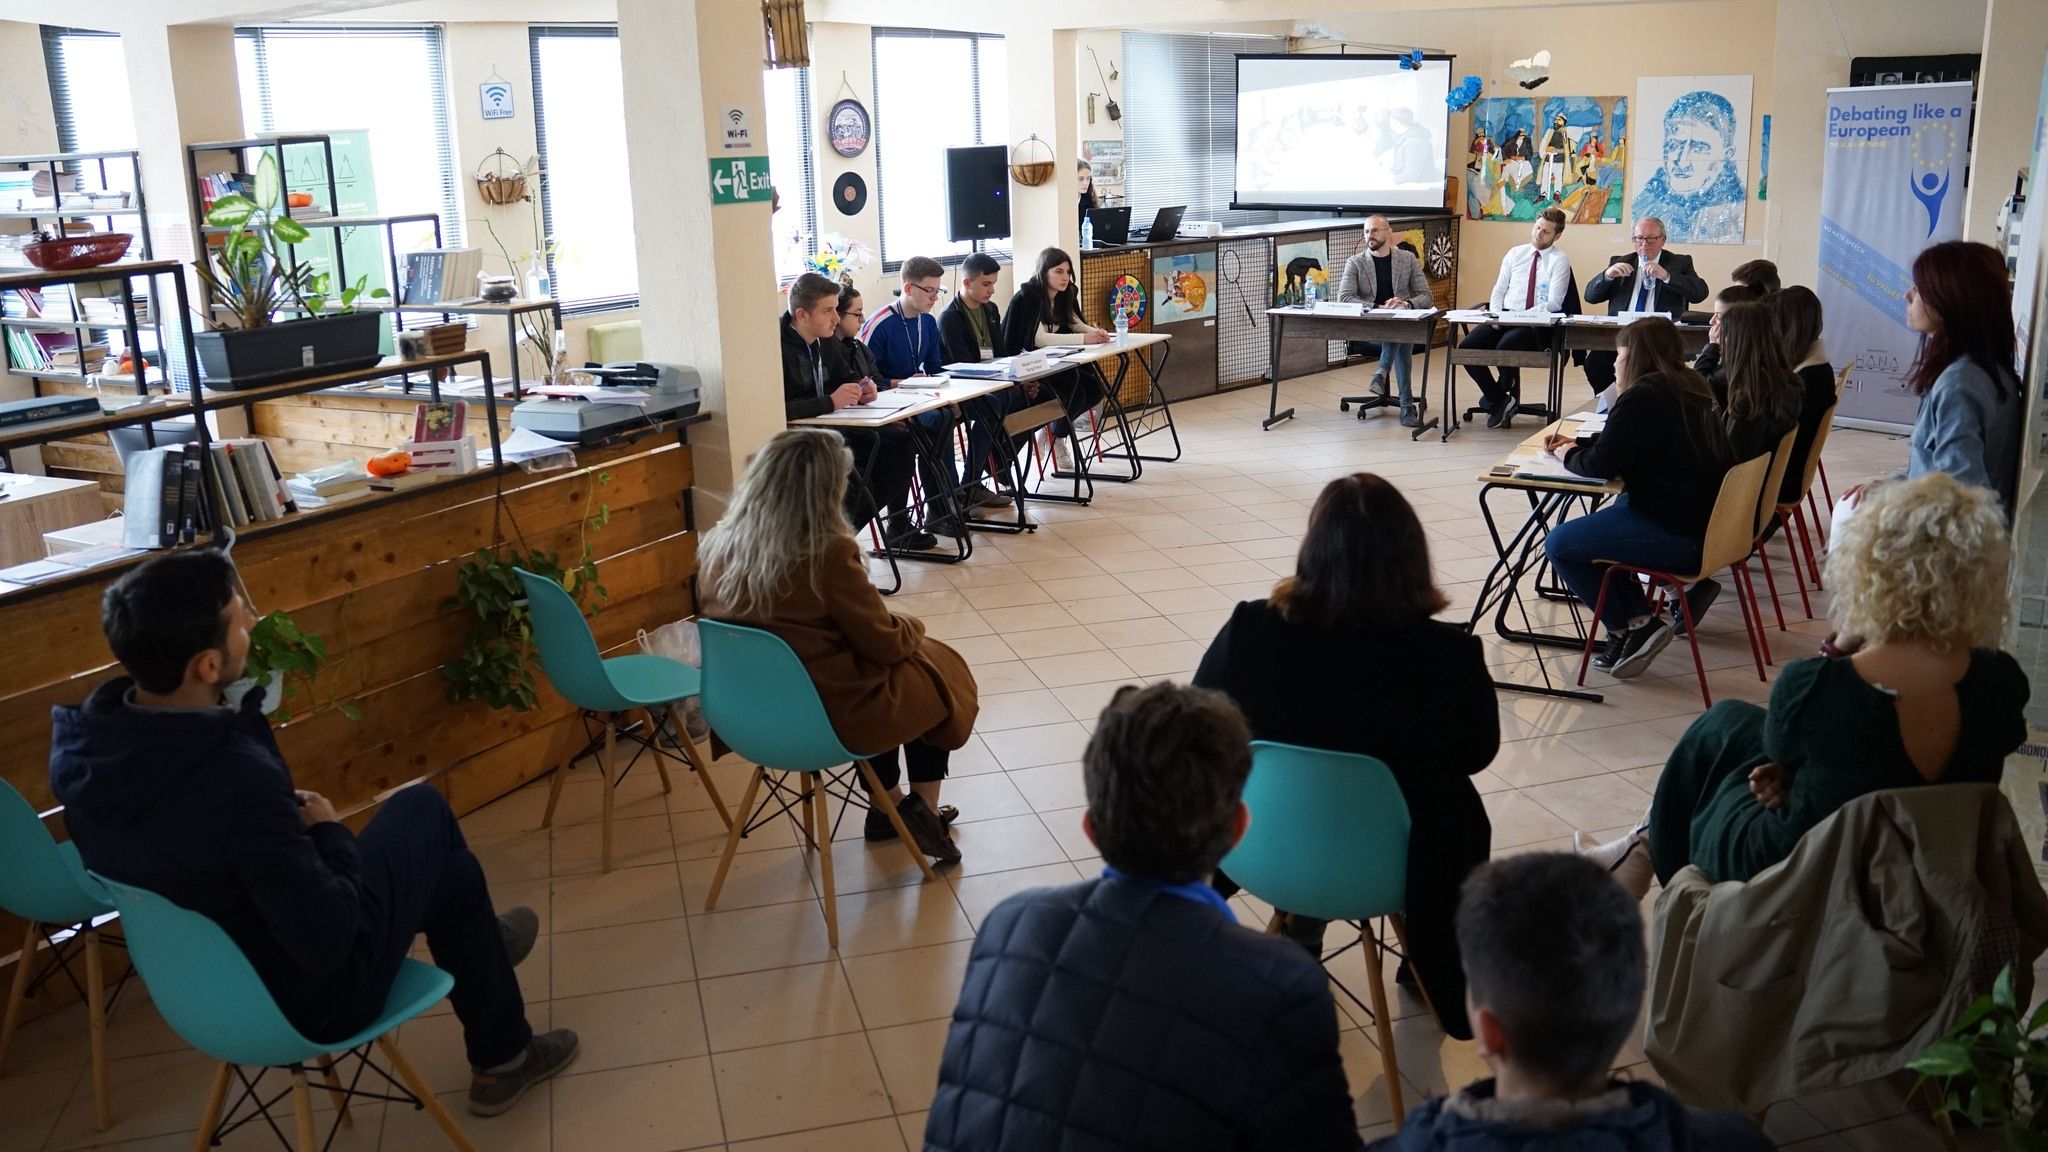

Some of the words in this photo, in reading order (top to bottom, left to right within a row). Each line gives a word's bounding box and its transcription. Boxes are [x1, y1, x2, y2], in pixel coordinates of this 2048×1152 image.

[485, 109, 499, 117] WiFi
[1830, 105, 1908, 124] Debating
[1913, 102, 1945, 119] like
[1950, 107, 1962, 118] a
[727, 129, 748, 138] Wi-Fi
[1829, 123, 1912, 141] European
[750, 171, 772, 190] Exit
